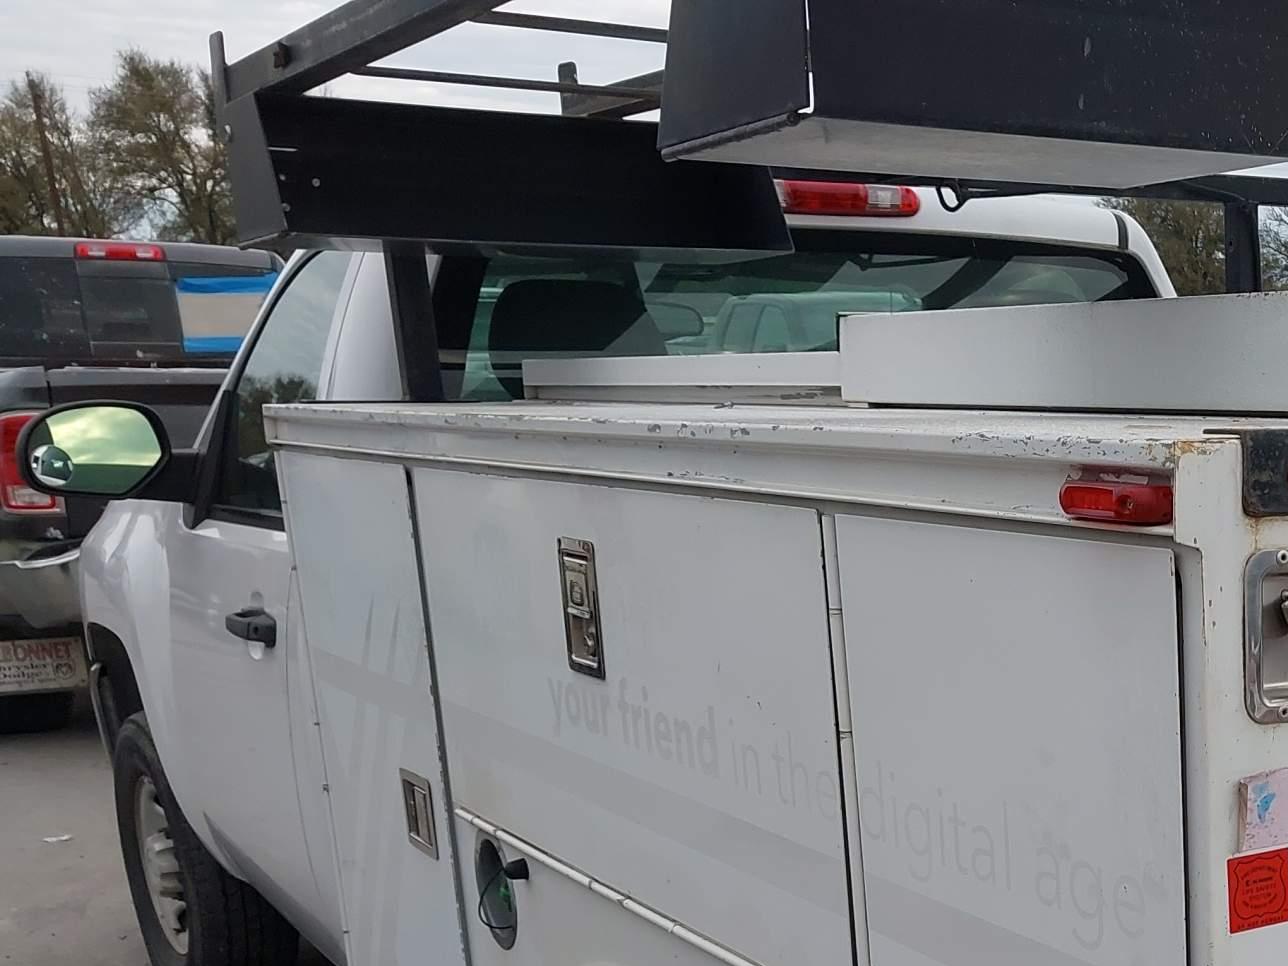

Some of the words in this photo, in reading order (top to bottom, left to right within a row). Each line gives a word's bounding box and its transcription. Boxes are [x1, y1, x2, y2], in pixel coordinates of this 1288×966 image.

[547, 676, 608, 737] your
[617, 678, 719, 778] friend
[726, 717, 764, 794] in
[771, 731, 838, 821] the
[860, 760, 1013, 890] digital
